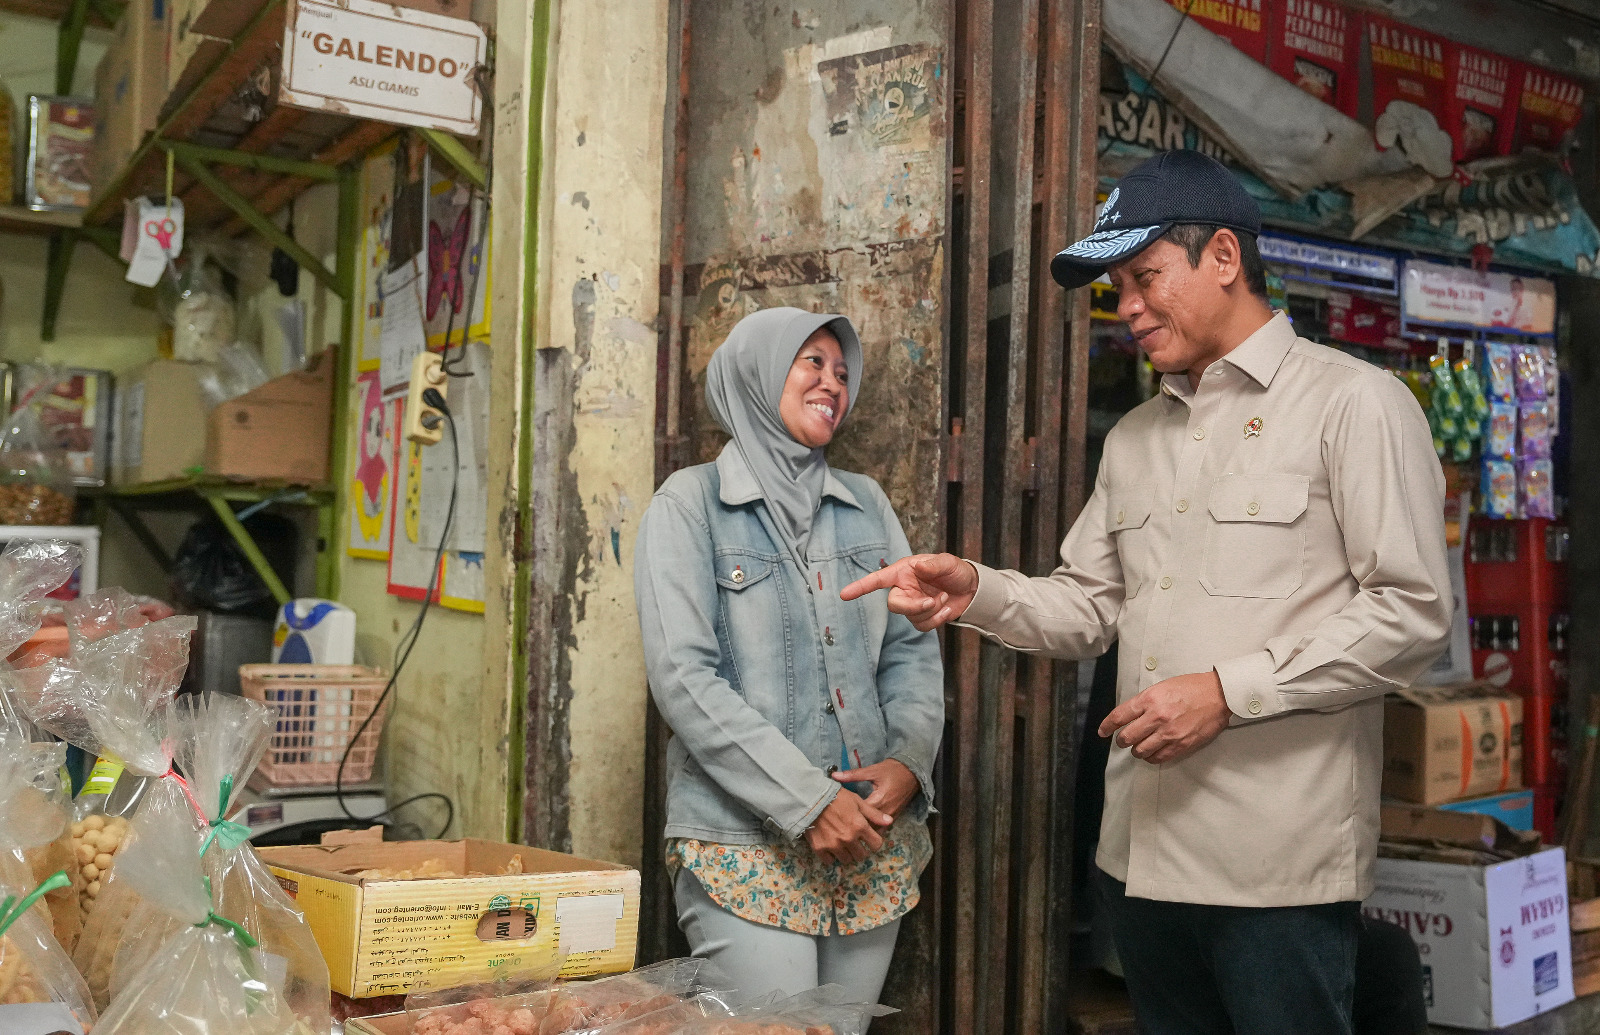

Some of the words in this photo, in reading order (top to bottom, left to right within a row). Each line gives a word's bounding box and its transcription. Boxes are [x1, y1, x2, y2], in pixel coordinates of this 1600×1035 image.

[1369, 22, 1443, 63] RASAKAN
[349, 76, 375, 89] ASLI
[378, 80, 420, 97] CIAMIS
[374, 914, 444, 924] www.orienteg.com
[375, 904, 447, 914] info@orienteg.com
[1521, 893, 1564, 926] GARAM
